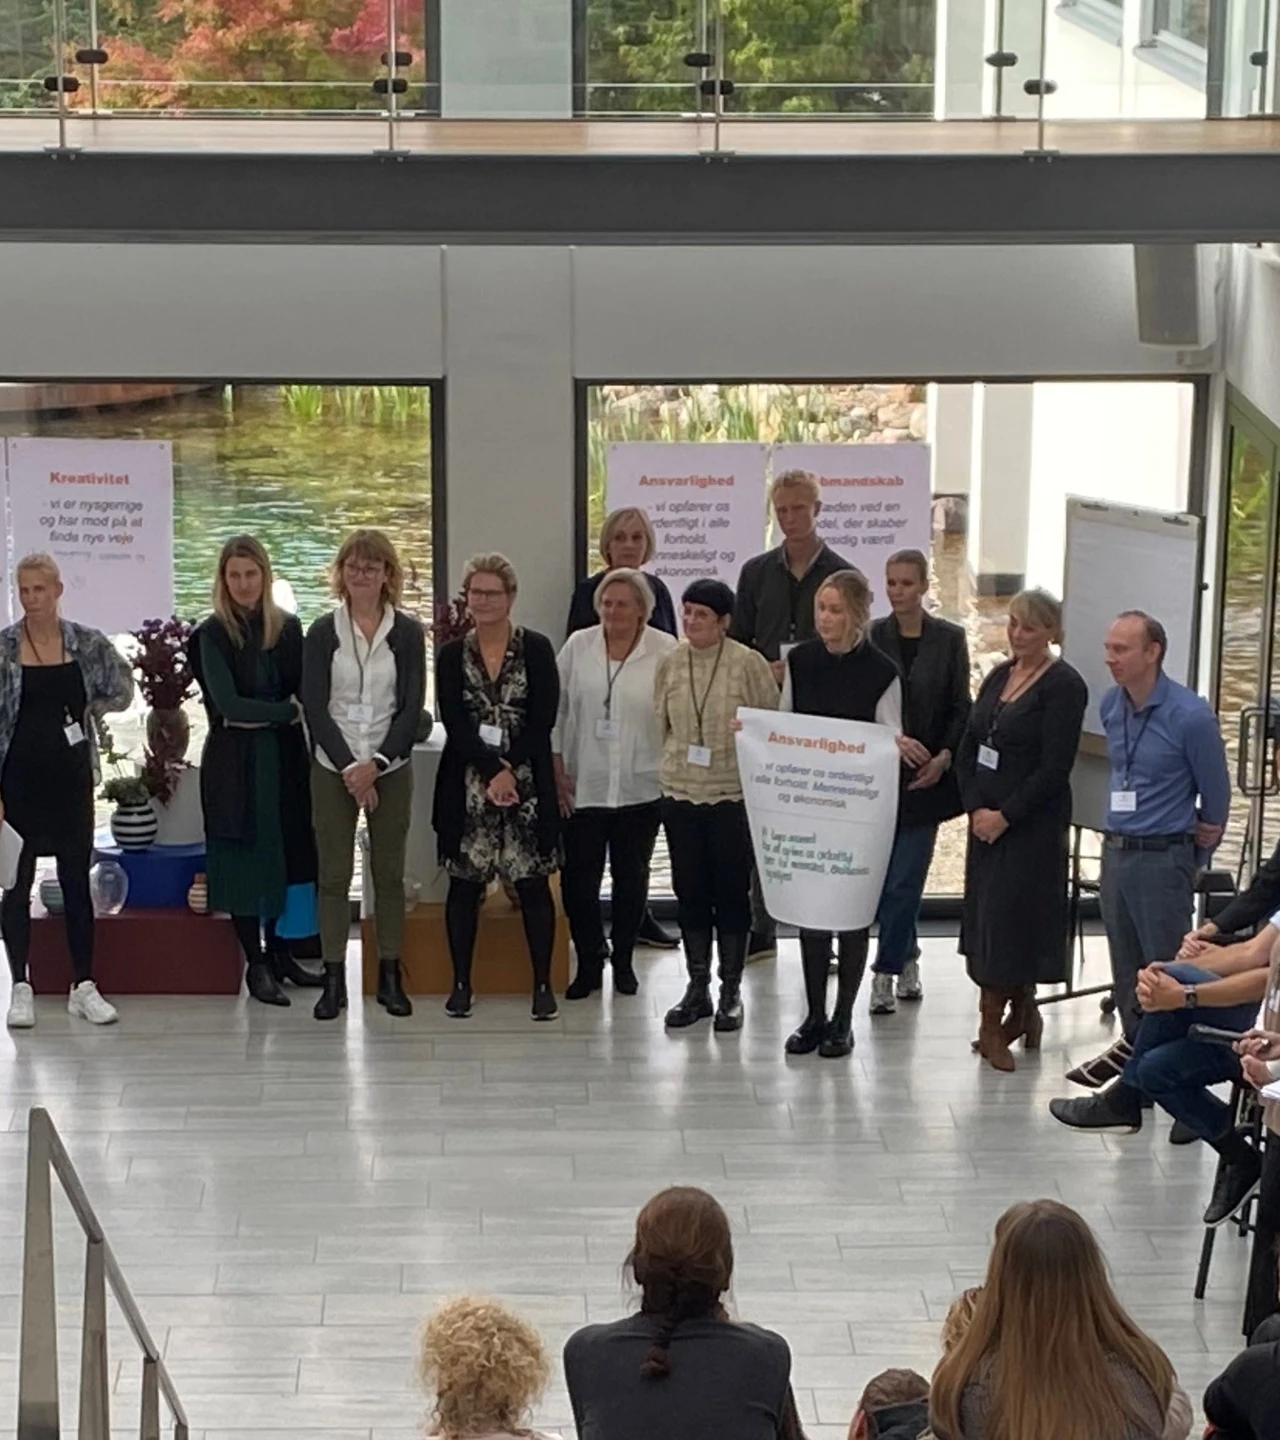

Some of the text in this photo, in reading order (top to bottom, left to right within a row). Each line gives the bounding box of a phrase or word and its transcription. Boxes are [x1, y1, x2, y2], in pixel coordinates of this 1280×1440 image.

[50, 472, 129, 484] Kreativitet
[640, 475, 734, 488] Ansvarlighed
[50, 500, 60, 509] vi
[64, 500, 76, 509] er
[656, 502, 665, 511] vi
[715, 503, 730, 512] os
[860, 502, 882, 512] ved
[885, 503, 901, 512] en
[39, 516, 55, 528] og
[58, 515, 78, 525] har
[82, 516, 109, 526] mod
[112, 516, 127, 528] på
[708, 518, 730, 528] alle
[843, 518, 863, 529] der
[83, 534, 104, 545] nye
[108, 533, 133, 545] veje
[720, 552, 736, 562] og
[768, 731, 866, 754] Ansvarlighed
[778, 792, 791, 803] og
